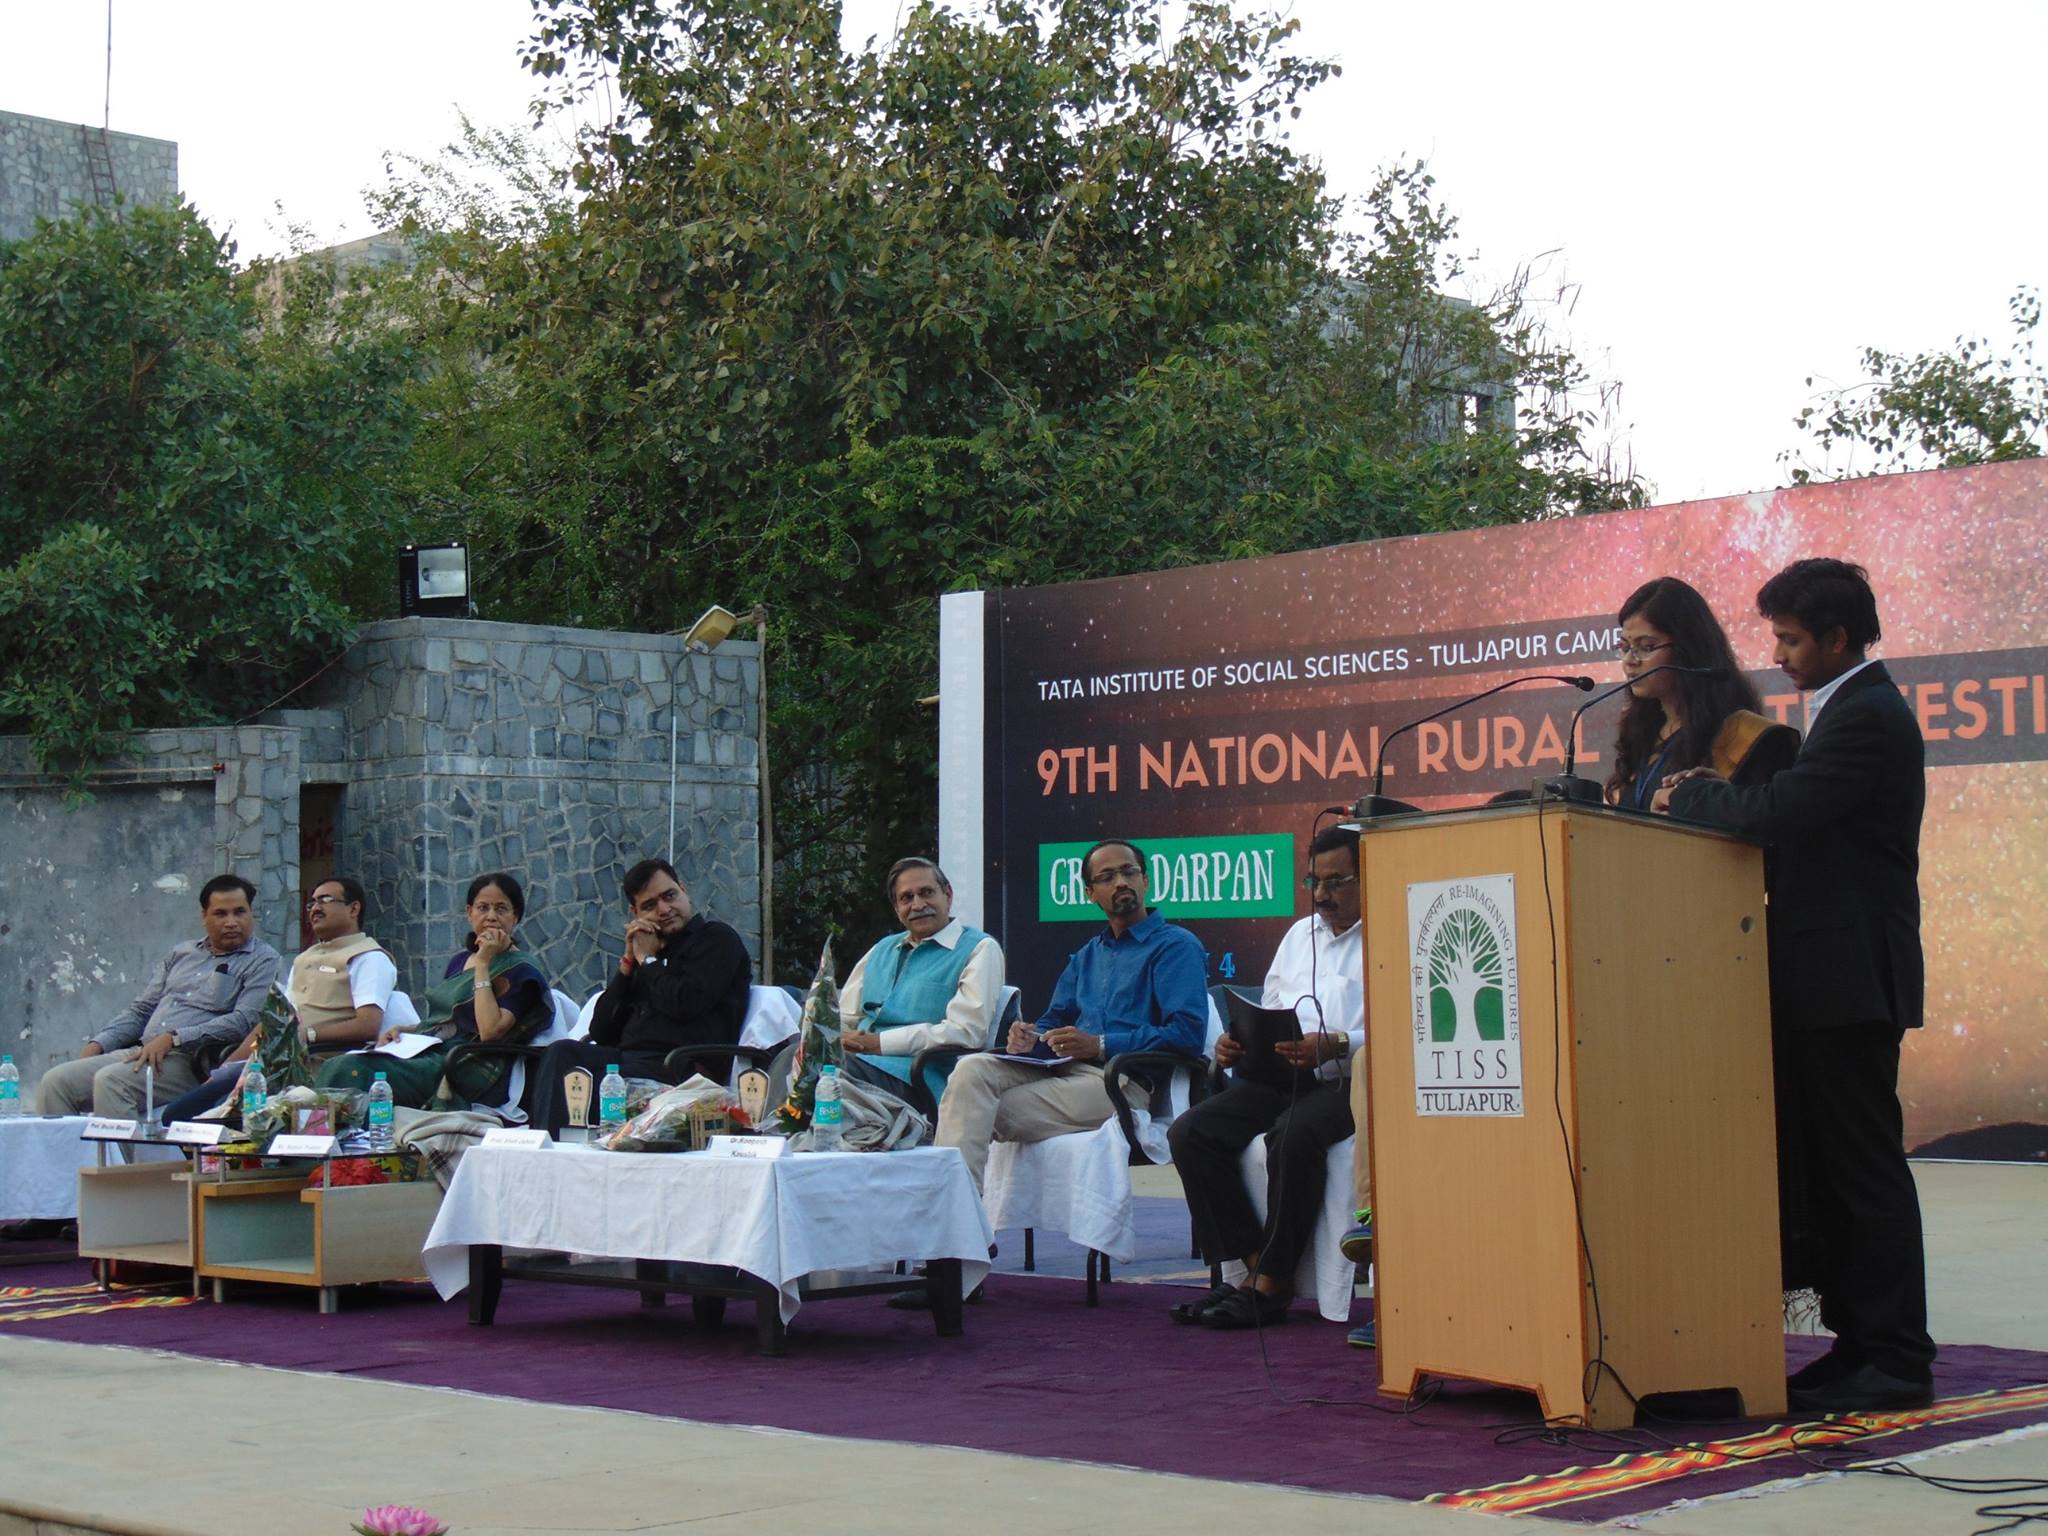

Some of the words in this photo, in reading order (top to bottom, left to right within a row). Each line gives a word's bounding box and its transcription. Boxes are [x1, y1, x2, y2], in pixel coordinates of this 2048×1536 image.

[1038, 679, 1085, 701] TATA
[1090, 669, 1185, 697] INSTITUTE
[1192, 666, 1218, 689] OF
[1223, 659, 1298, 686] SOCIAL
[1304, 648, 1409, 679] SCIENCES
[1429, 634, 1547, 667] TULJAPUR
[1555, 627, 1623, 655] CAMP
[1037, 744, 1117, 796] 9TH
[1139, 726, 1394, 790] NATIONAL
[1417, 711, 1600, 774] RURAL
[1898, 675, 2046, 741] ESTI
[1051, 857, 1092, 905] GR
[1151, 849, 1274, 903] DARPAN
[1449, 885, 1513, 951] RE-IMAGINING
[1507, 956, 1518, 1040] FUTURES
[1432, 1049, 1507, 1079] TISS
[1422, 1092, 1516, 1112] TULJAPUR
